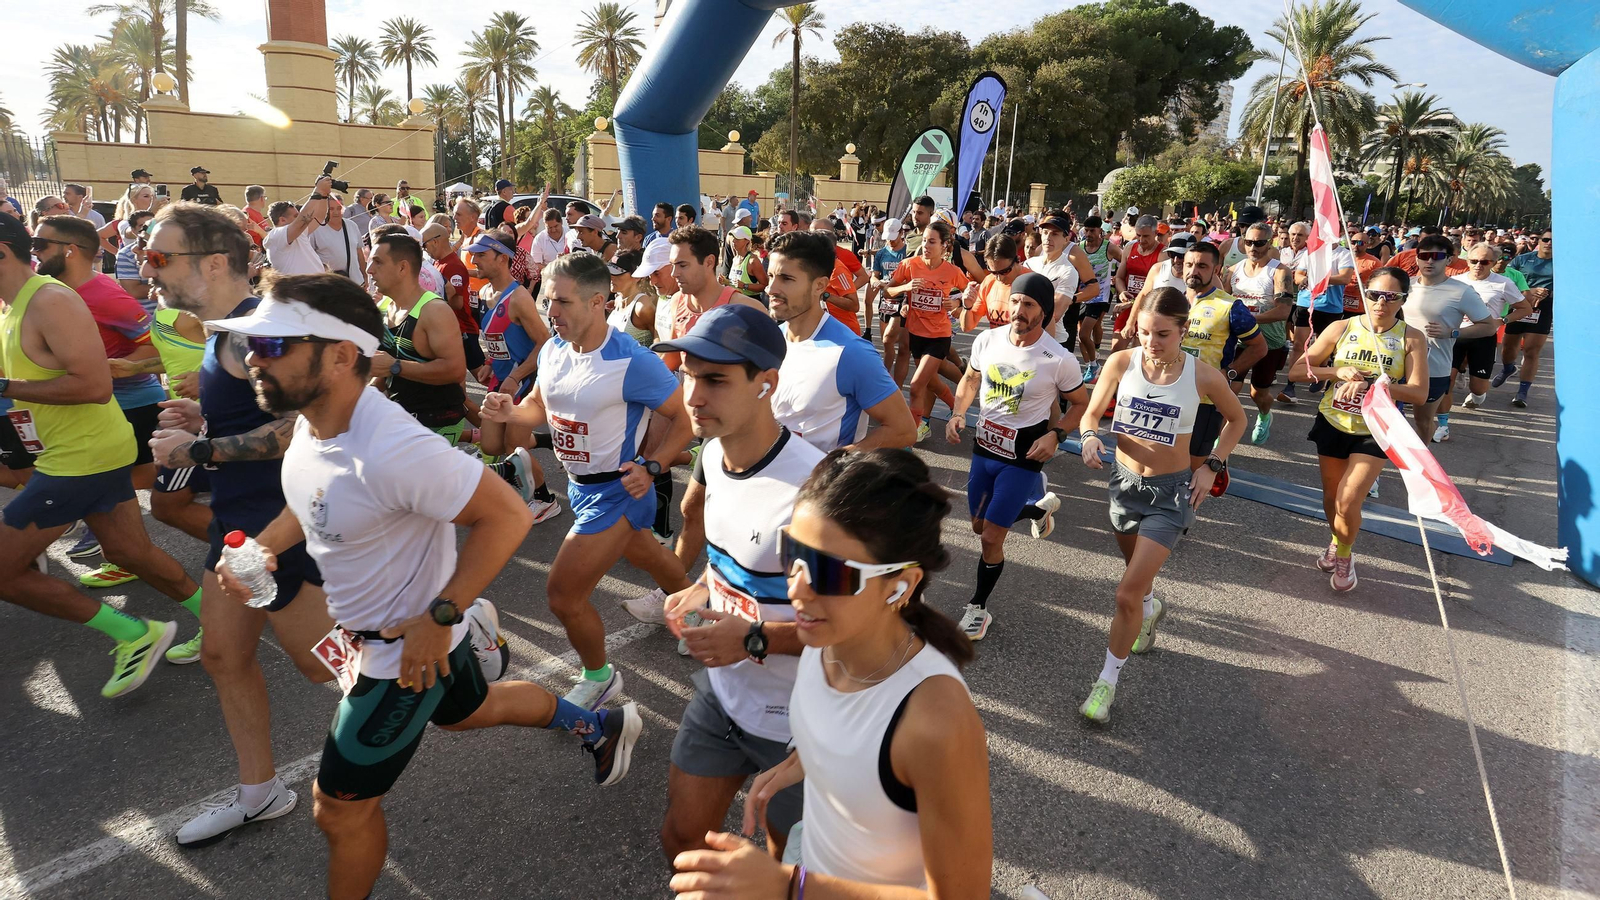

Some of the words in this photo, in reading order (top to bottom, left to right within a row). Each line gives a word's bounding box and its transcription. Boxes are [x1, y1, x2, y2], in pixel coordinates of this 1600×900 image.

[978, 104, 989, 117] 1h
[914, 163, 939, 171] SPORT
[918, 295, 934, 305] 462
[1130, 411, 1164, 430] 717
[553, 430, 575, 449] 458
[983, 430, 1004, 446] 167
[371, 694, 416, 745] WONG
